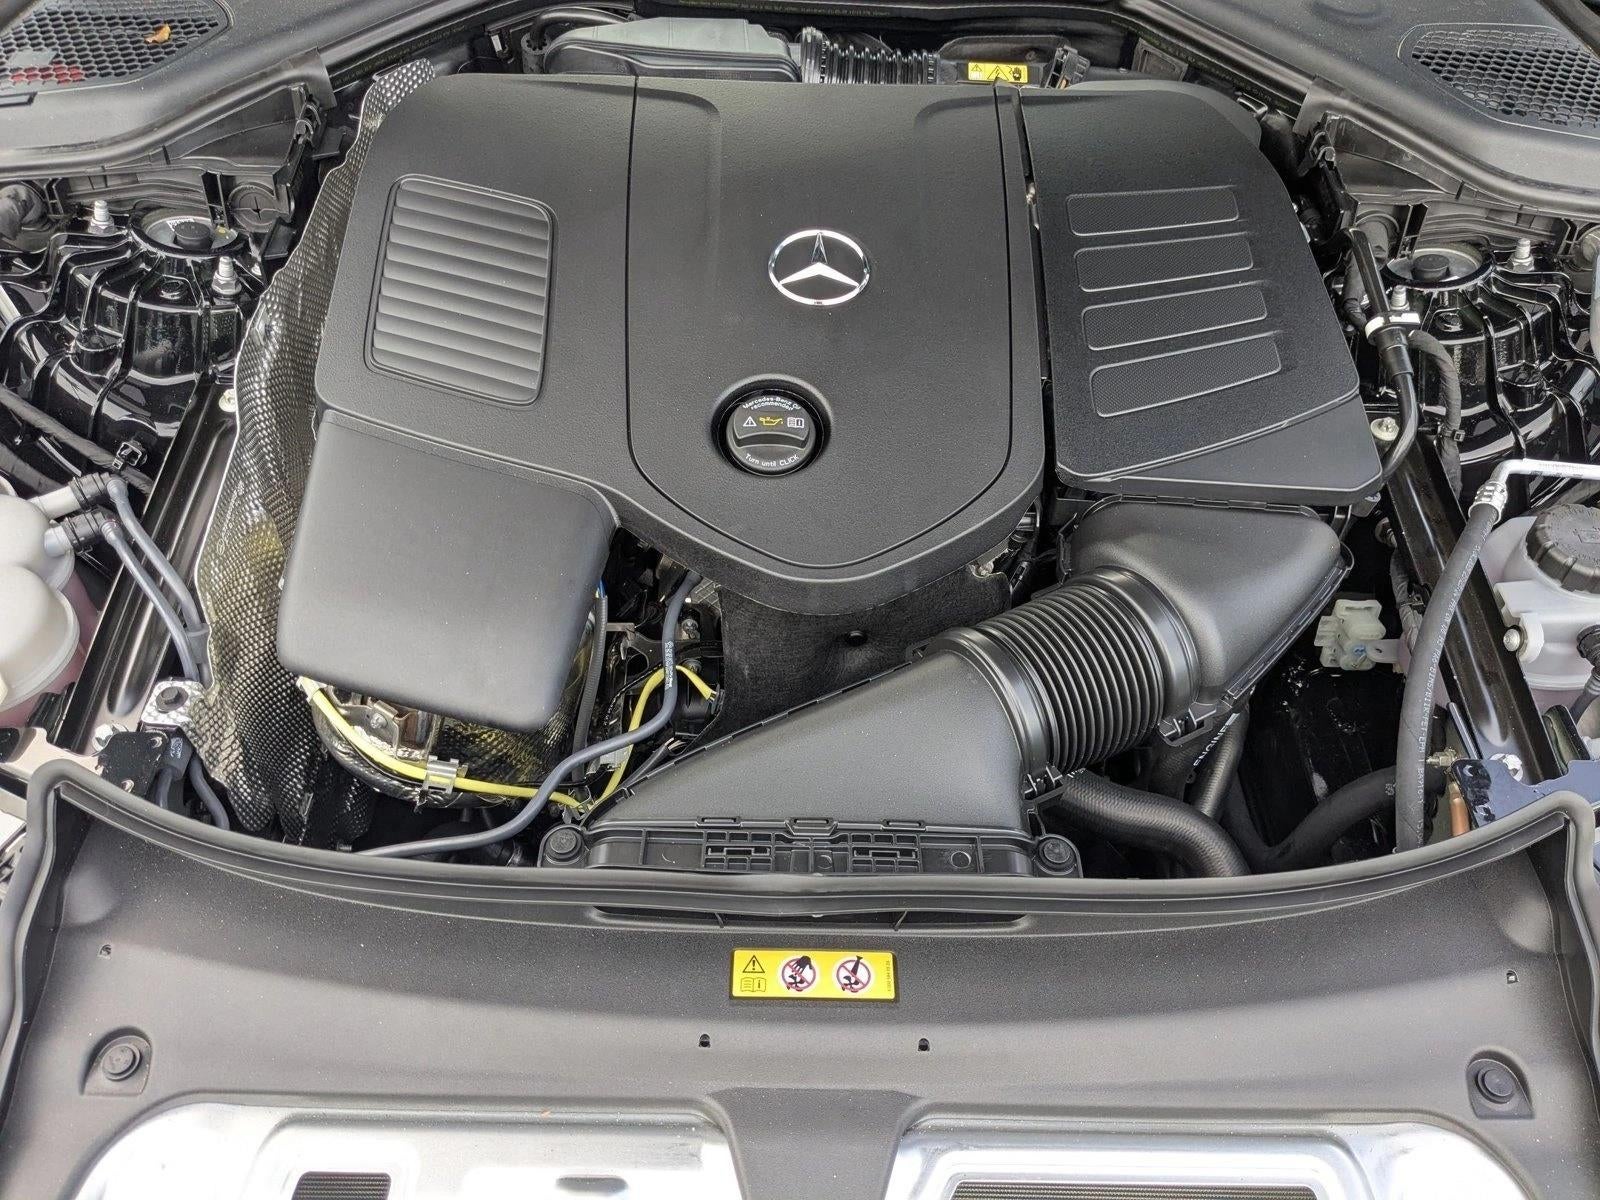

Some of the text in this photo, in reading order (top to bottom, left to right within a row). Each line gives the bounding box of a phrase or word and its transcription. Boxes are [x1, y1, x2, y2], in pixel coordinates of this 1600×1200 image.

[745, 453, 760, 465] Turn
[779, 454, 800, 467] CLICK
[1193, 724, 1228, 767] ENGINE
